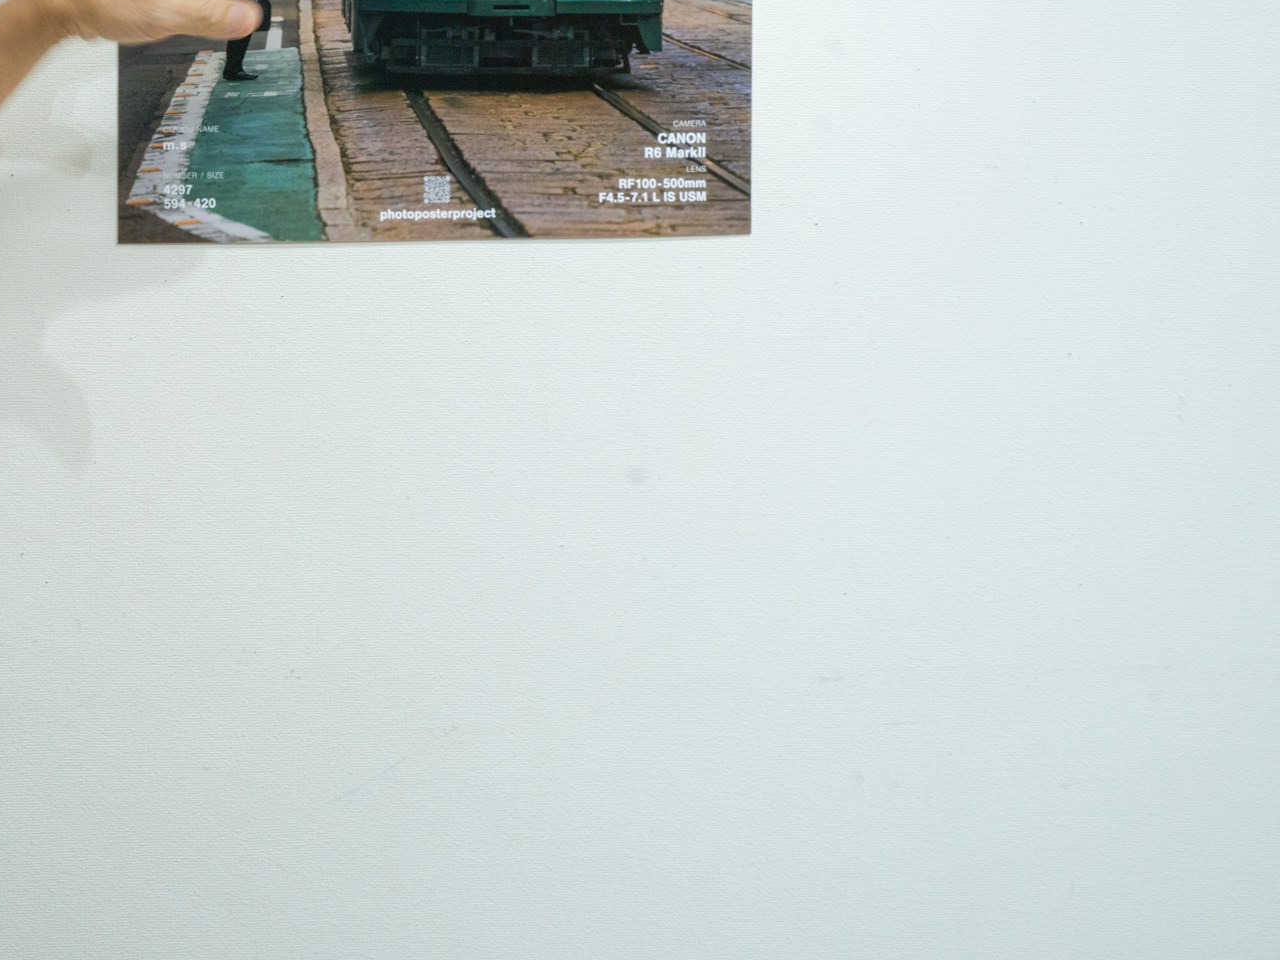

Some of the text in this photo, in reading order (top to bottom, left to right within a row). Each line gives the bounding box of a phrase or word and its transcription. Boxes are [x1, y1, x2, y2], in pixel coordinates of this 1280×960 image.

[672, 120, 707, 128] CAMERA
[657, 133, 707, 144] CANON
[644, 147, 662, 158] R6
[686, 165, 708, 173] LENS
[206, 171, 225, 179] SIZE
[618, 178, 707, 189] RF100-500mm
[163, 184, 193, 196] 4297
[598, 191, 707, 203] F4.5-7.1 L IS USM
[379, 208, 497, 221] photoposterproject
